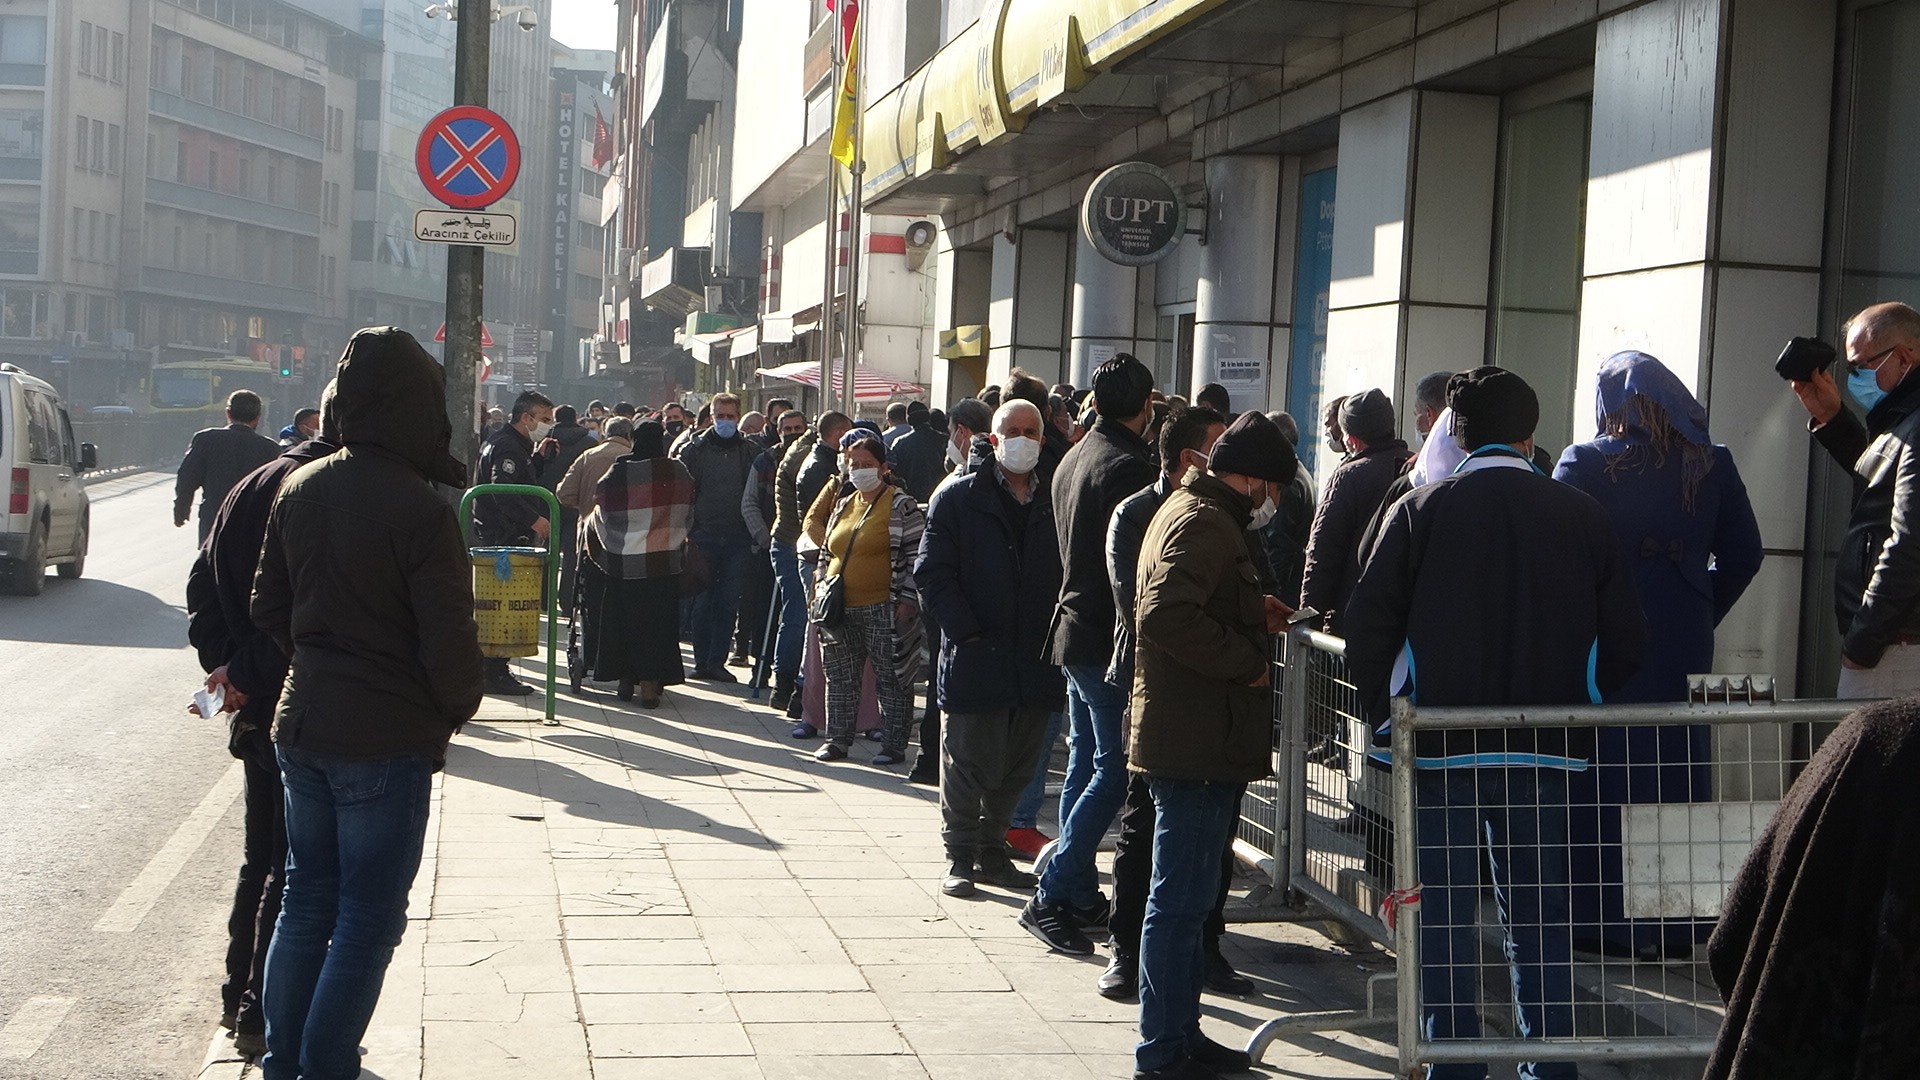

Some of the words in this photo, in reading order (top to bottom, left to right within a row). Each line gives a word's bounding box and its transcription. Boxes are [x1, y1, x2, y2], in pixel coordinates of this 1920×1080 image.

[558, 108, 572, 186] HOTEL
[1104, 196, 1174, 225] UPT
[420, 227, 470, 239] Aracınız
[474, 230, 511, 241] Çekilir
